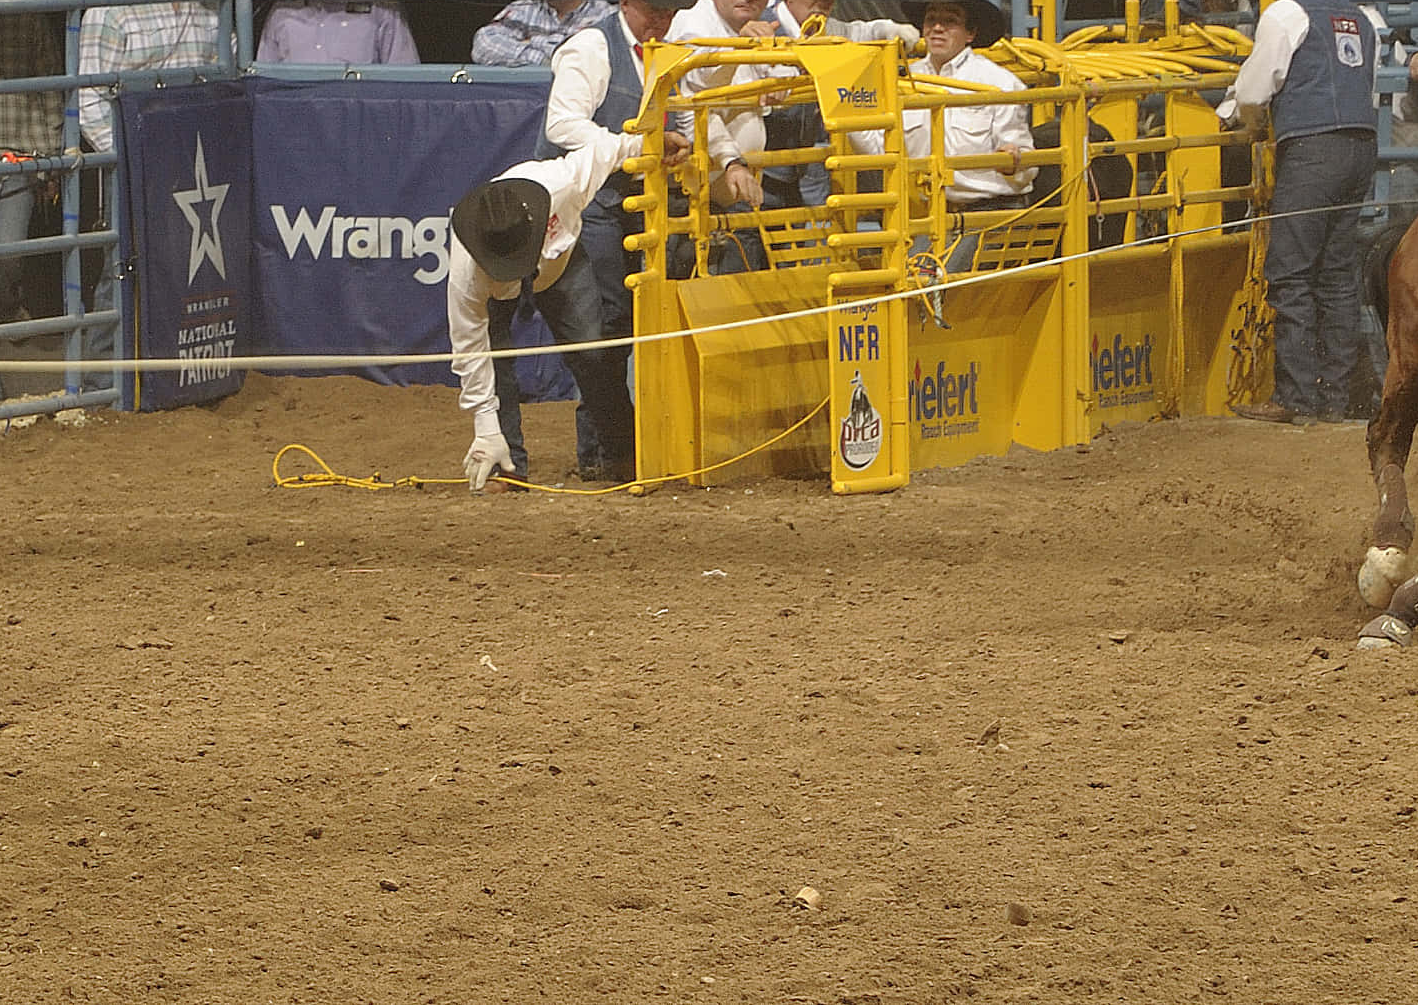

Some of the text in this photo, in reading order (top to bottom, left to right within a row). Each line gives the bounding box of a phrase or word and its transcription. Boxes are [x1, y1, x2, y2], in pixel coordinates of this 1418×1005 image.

[837, 86, 877, 103] Priefert
[269, 205, 454, 285] Wrang
[839, 325, 879, 362] NFR
[1090, 334, 1152, 392] iefert
[908, 359, 978, 423] riefert
